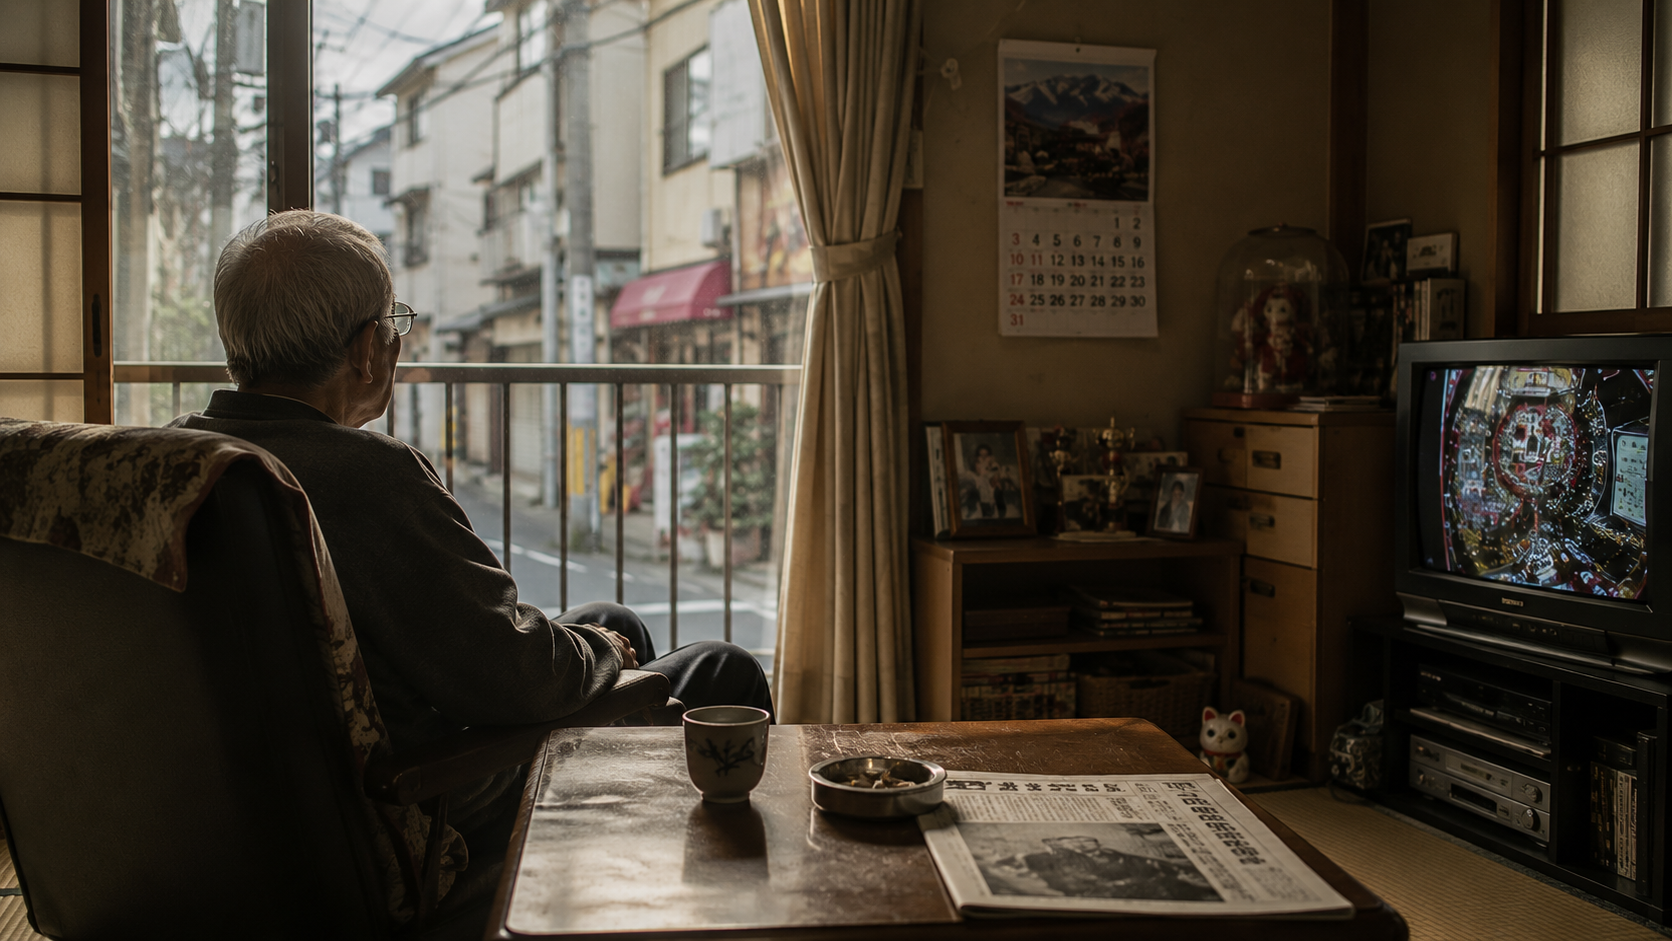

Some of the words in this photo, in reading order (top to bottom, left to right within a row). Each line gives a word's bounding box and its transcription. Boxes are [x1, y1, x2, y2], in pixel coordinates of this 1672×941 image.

[1133, 217, 1141, 229] 2
[1012, 233, 1020, 245] 3
[1032, 234, 1040, 246] 4
[1053, 234, 1062, 247] 5
[1073, 235, 1082, 247] 6
[1093, 235, 1101, 247] 7
[1113, 236, 1121, 248] 8
[1133, 237, 1141, 249] 9
[1010, 253, 1024, 265] 10
[1030, 254, 1043, 266] 11
[1050, 254, 1065, 266] 12
[1071, 255, 1085, 266] 13
[1091, 255, 1105, 267] 14
[1111, 256, 1125, 268] 15
[1131, 256, 1145, 268] 16
[1010, 273, 1024, 285] 17
[1031, 274, 1045, 286] 18
[1051, 274, 1065, 286] 19
[1070, 275, 1085, 287] 20
[1090, 275, 1104, 287] 21
[1111, 276, 1126, 287] 22
[1130, 276, 1145, 288] 23
[1009, 294, 1024, 306] 24
[1030, 294, 1045, 306] 25
[1050, 294, 1065, 306] 26
[1070, 295, 1085, 307] 27
[1090, 295, 1106, 307] 28
[1111, 295, 1126, 308] 29
[1131, 296, 1146, 307] 30
[1010, 314, 1024, 326] 31
